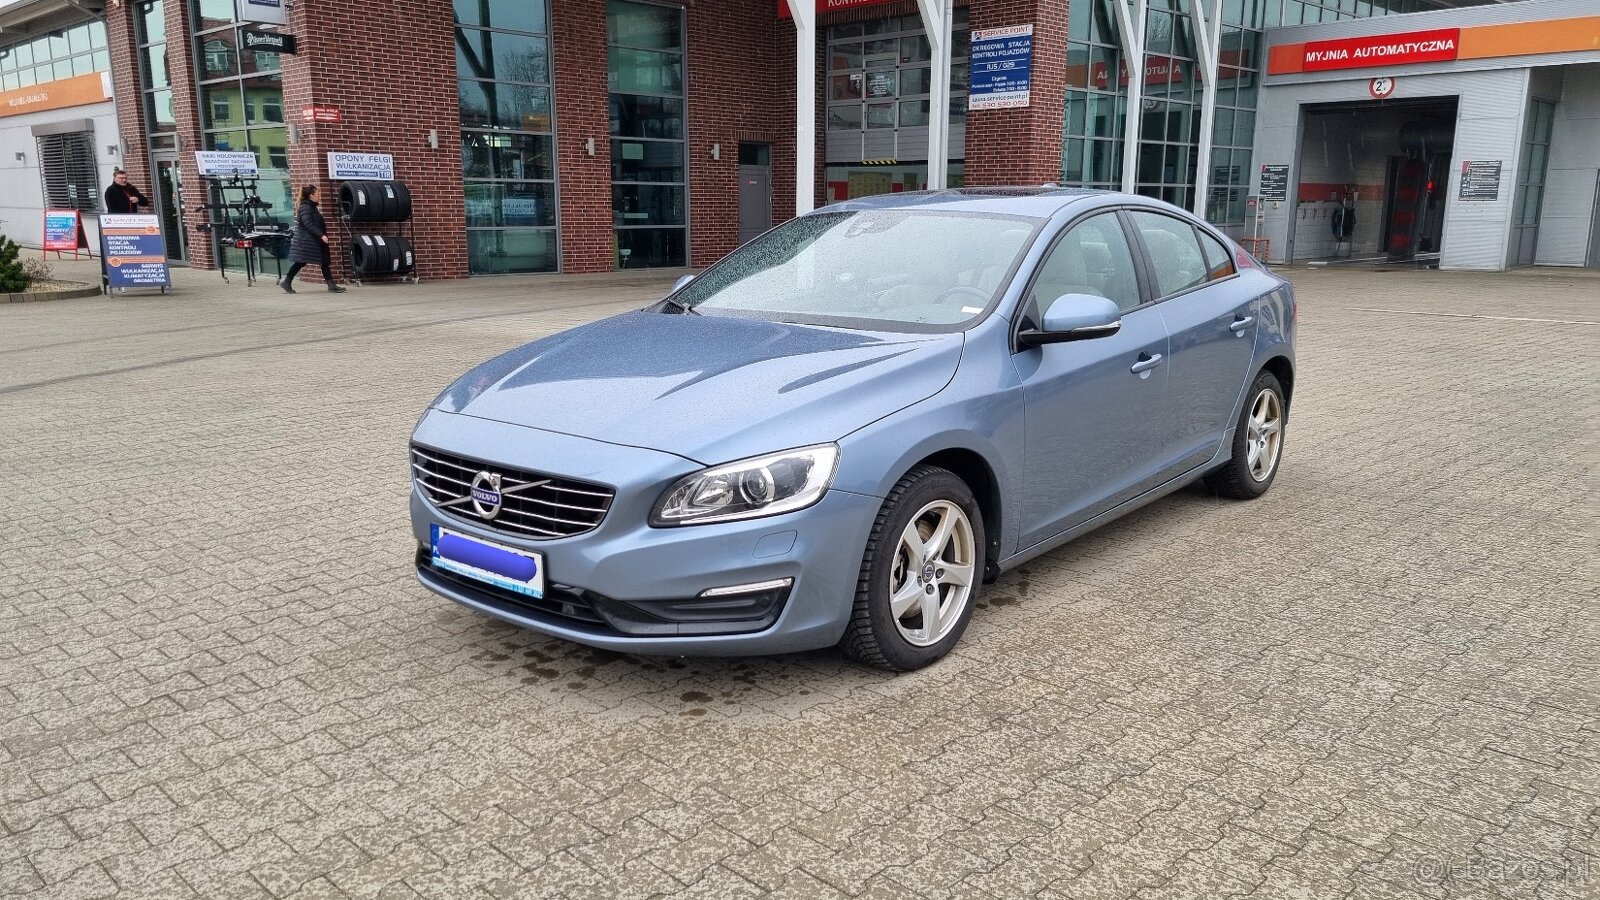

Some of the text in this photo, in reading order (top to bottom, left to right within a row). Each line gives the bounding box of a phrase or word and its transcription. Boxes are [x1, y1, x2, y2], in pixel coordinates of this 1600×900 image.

[982, 26, 1029, 37] SERVICE POINT
[1008, 40, 1031, 48] STACJA
[1306, 39, 1454, 62] MYJNIA AUTOMATYCZNA
[472, 490, 498, 503] VOLVO
